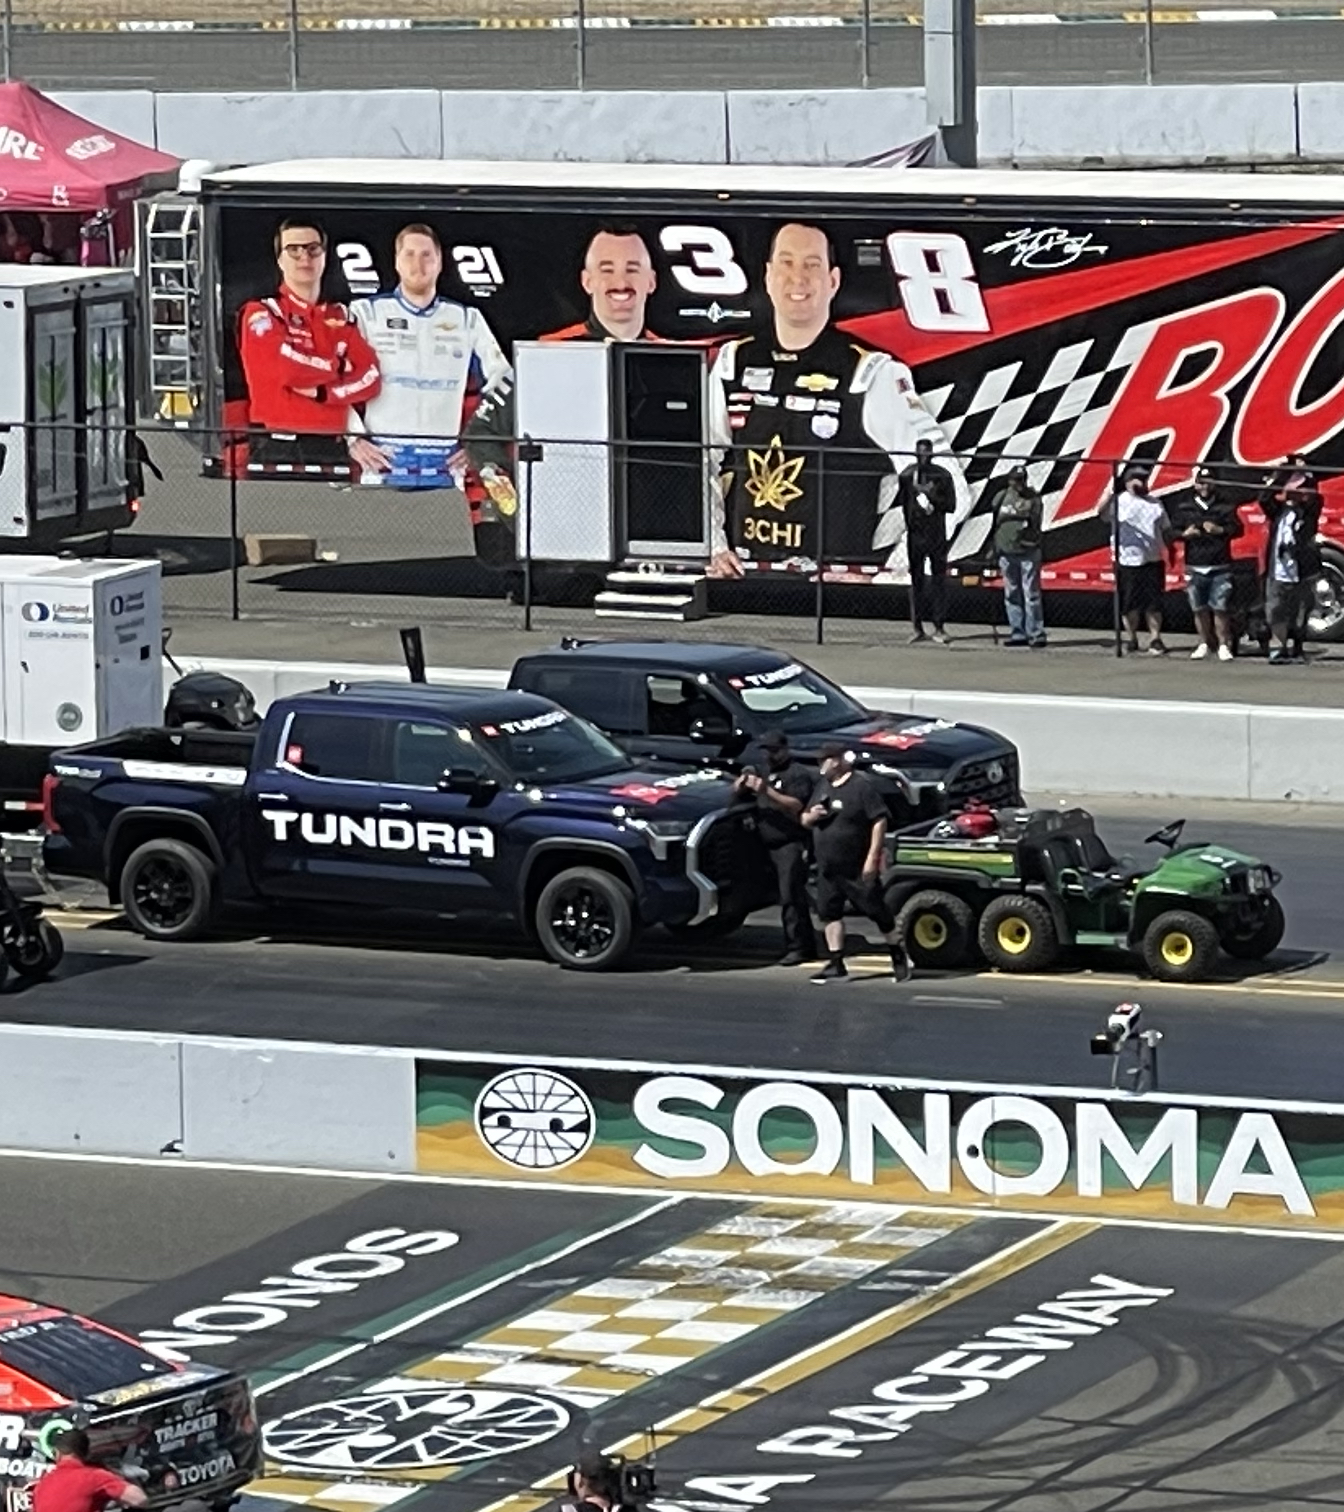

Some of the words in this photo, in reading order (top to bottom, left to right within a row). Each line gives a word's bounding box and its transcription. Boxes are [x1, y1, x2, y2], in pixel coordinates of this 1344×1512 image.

[336, 243, 380, 283] 2
[452, 246, 505, 285] 21
[659, 225, 749, 296] 3
[886, 230, 992, 333] 8
[744, 516, 804, 548] 3CHI
[262, 809, 494, 858] TUNDRA
[632, 1074, 1316, 1219] SONOMA
[756, 1271, 1169, 1458] RACEWAY
[176, 1452, 237, 1486] TOYOTA
